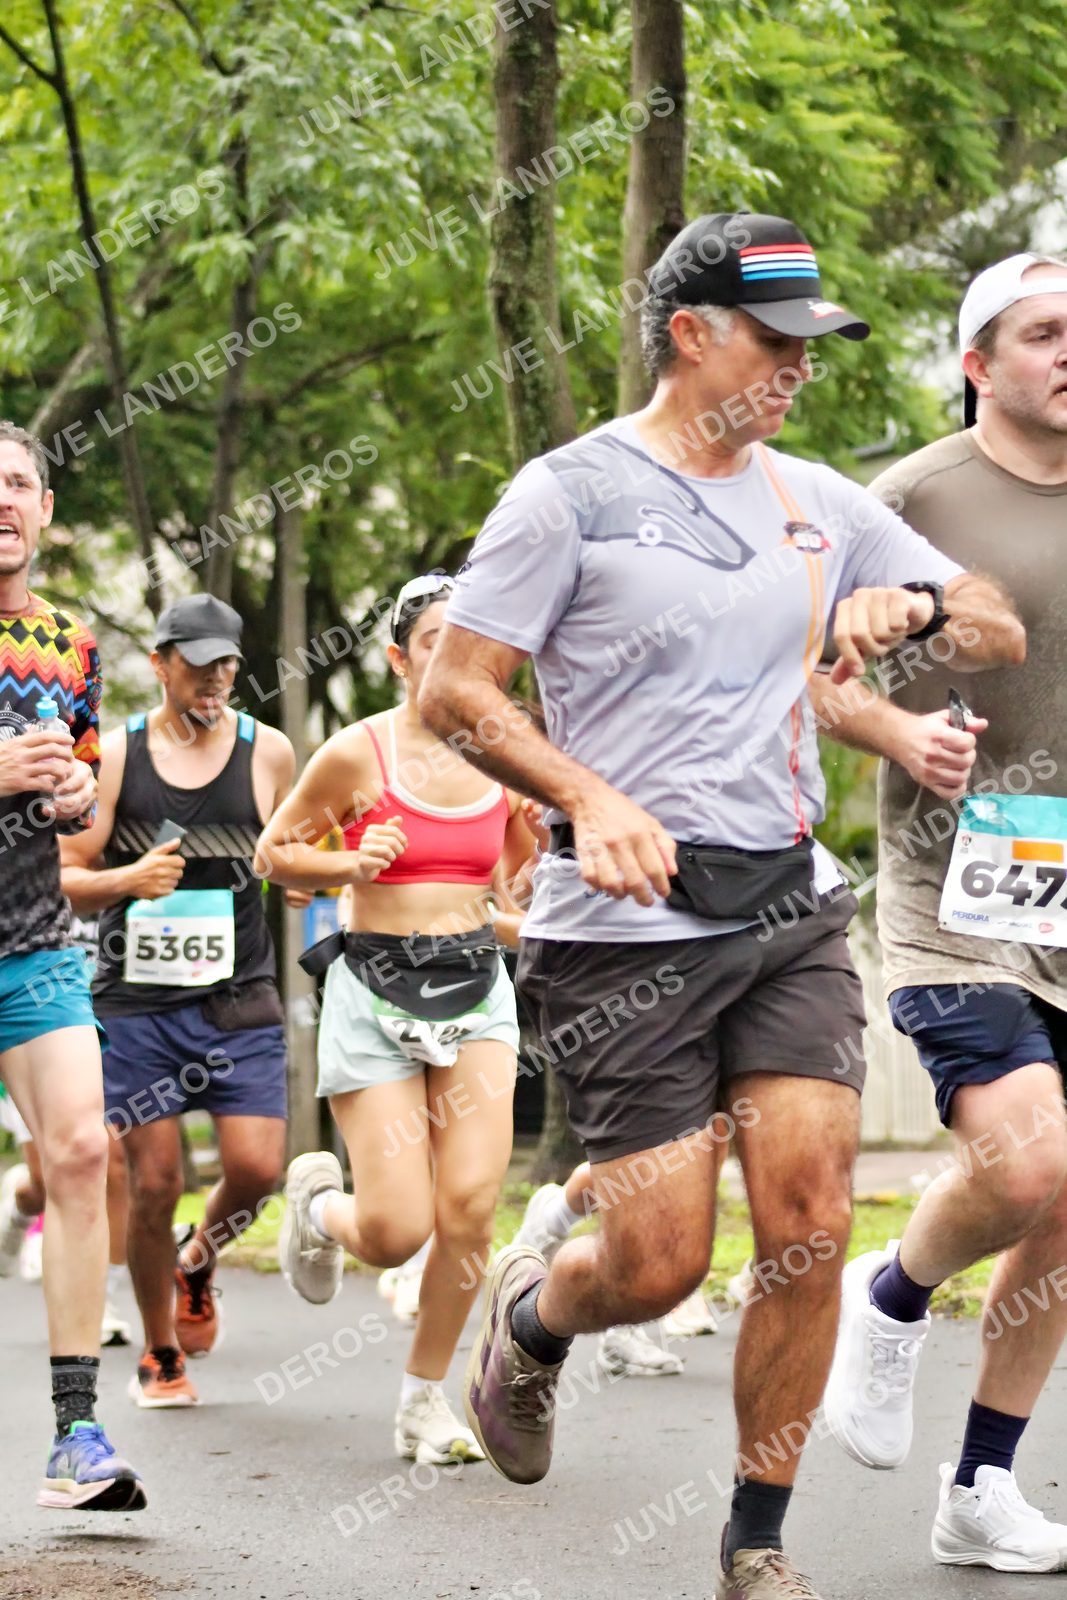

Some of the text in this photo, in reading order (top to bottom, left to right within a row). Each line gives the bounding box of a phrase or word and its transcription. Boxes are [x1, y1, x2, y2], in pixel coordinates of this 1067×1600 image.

[961, 860, 1067, 910] 647
[952, 910, 990, 922] PERDURA
[135, 935, 225, 962] 5365
